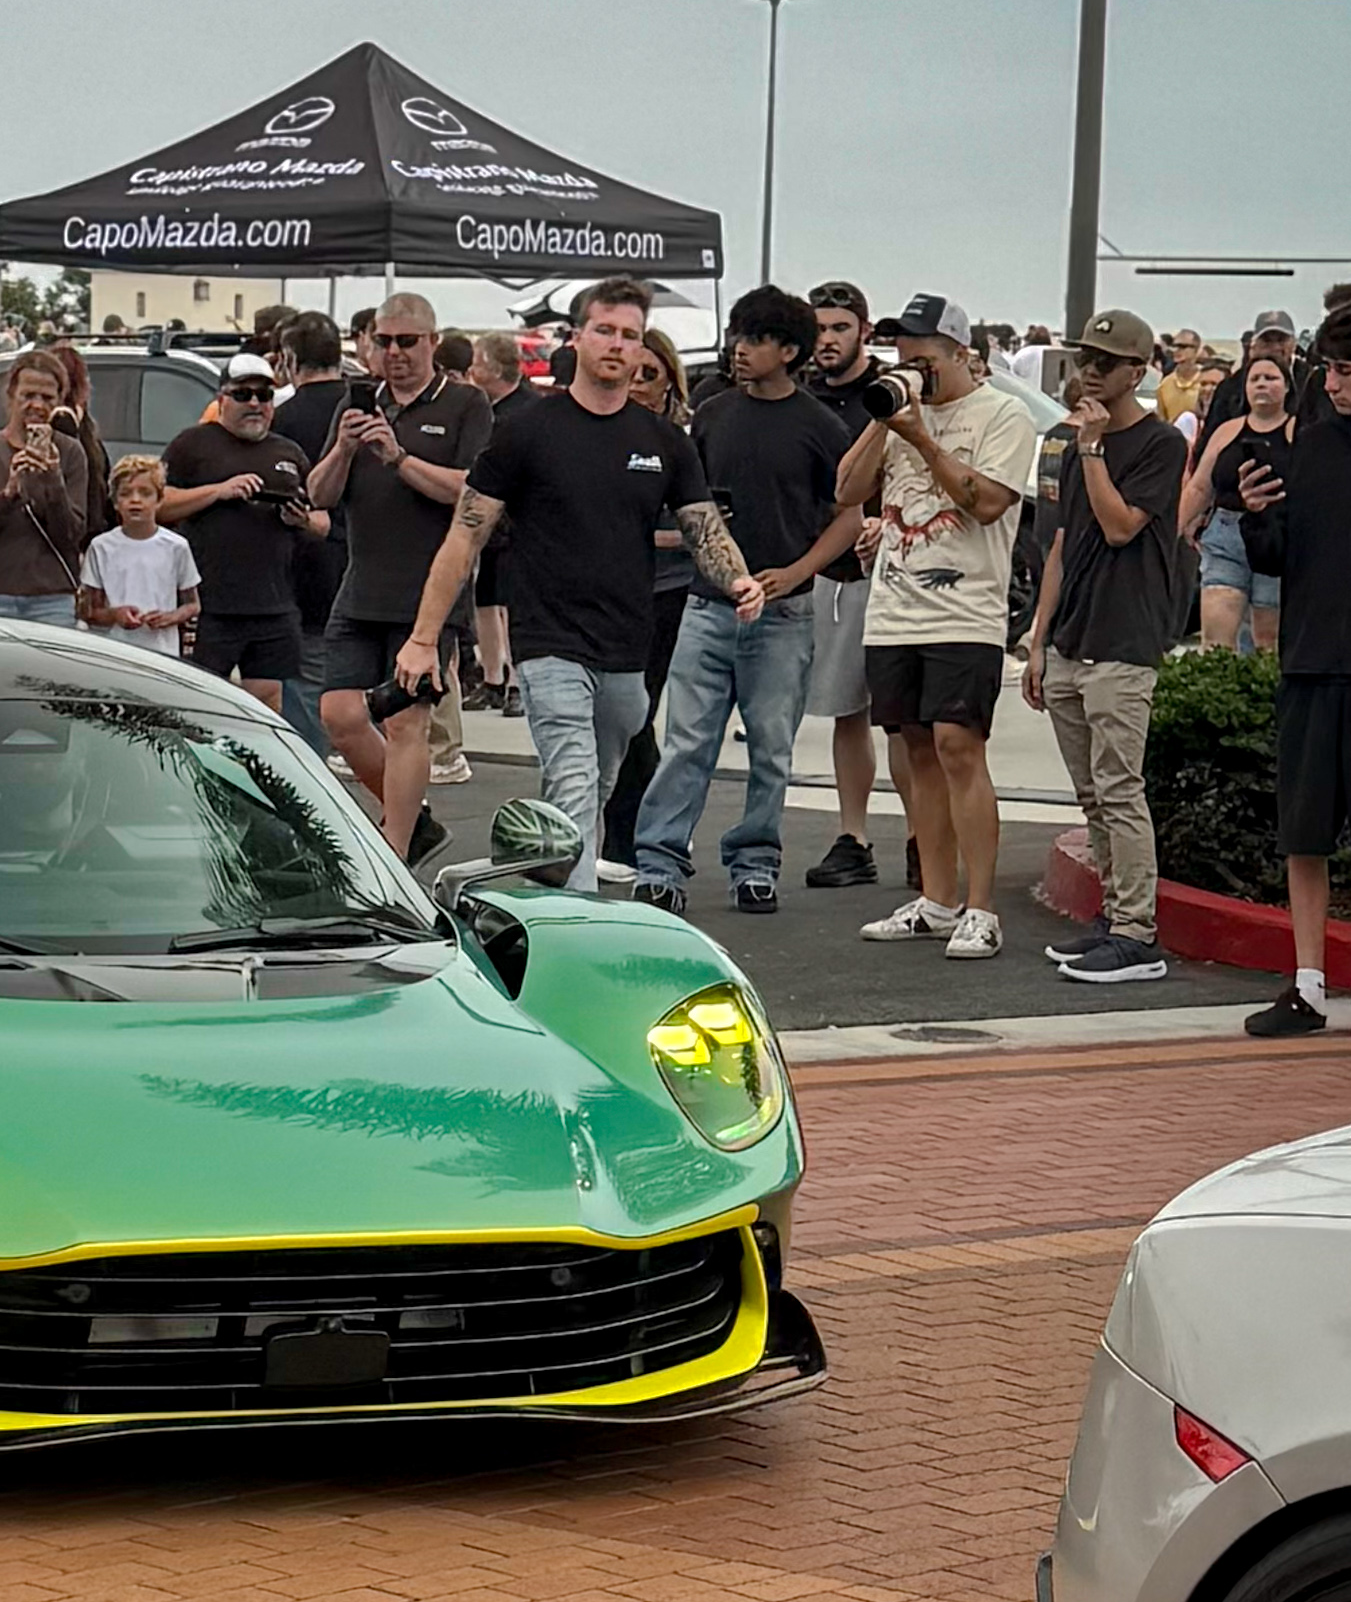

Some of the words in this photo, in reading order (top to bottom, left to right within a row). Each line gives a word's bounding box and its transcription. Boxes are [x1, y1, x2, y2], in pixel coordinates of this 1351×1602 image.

[270, 158, 366, 176] Mazda
[63, 212, 312, 257] CapoMazda.com
[455, 214, 664, 260] CapoMazda.com
